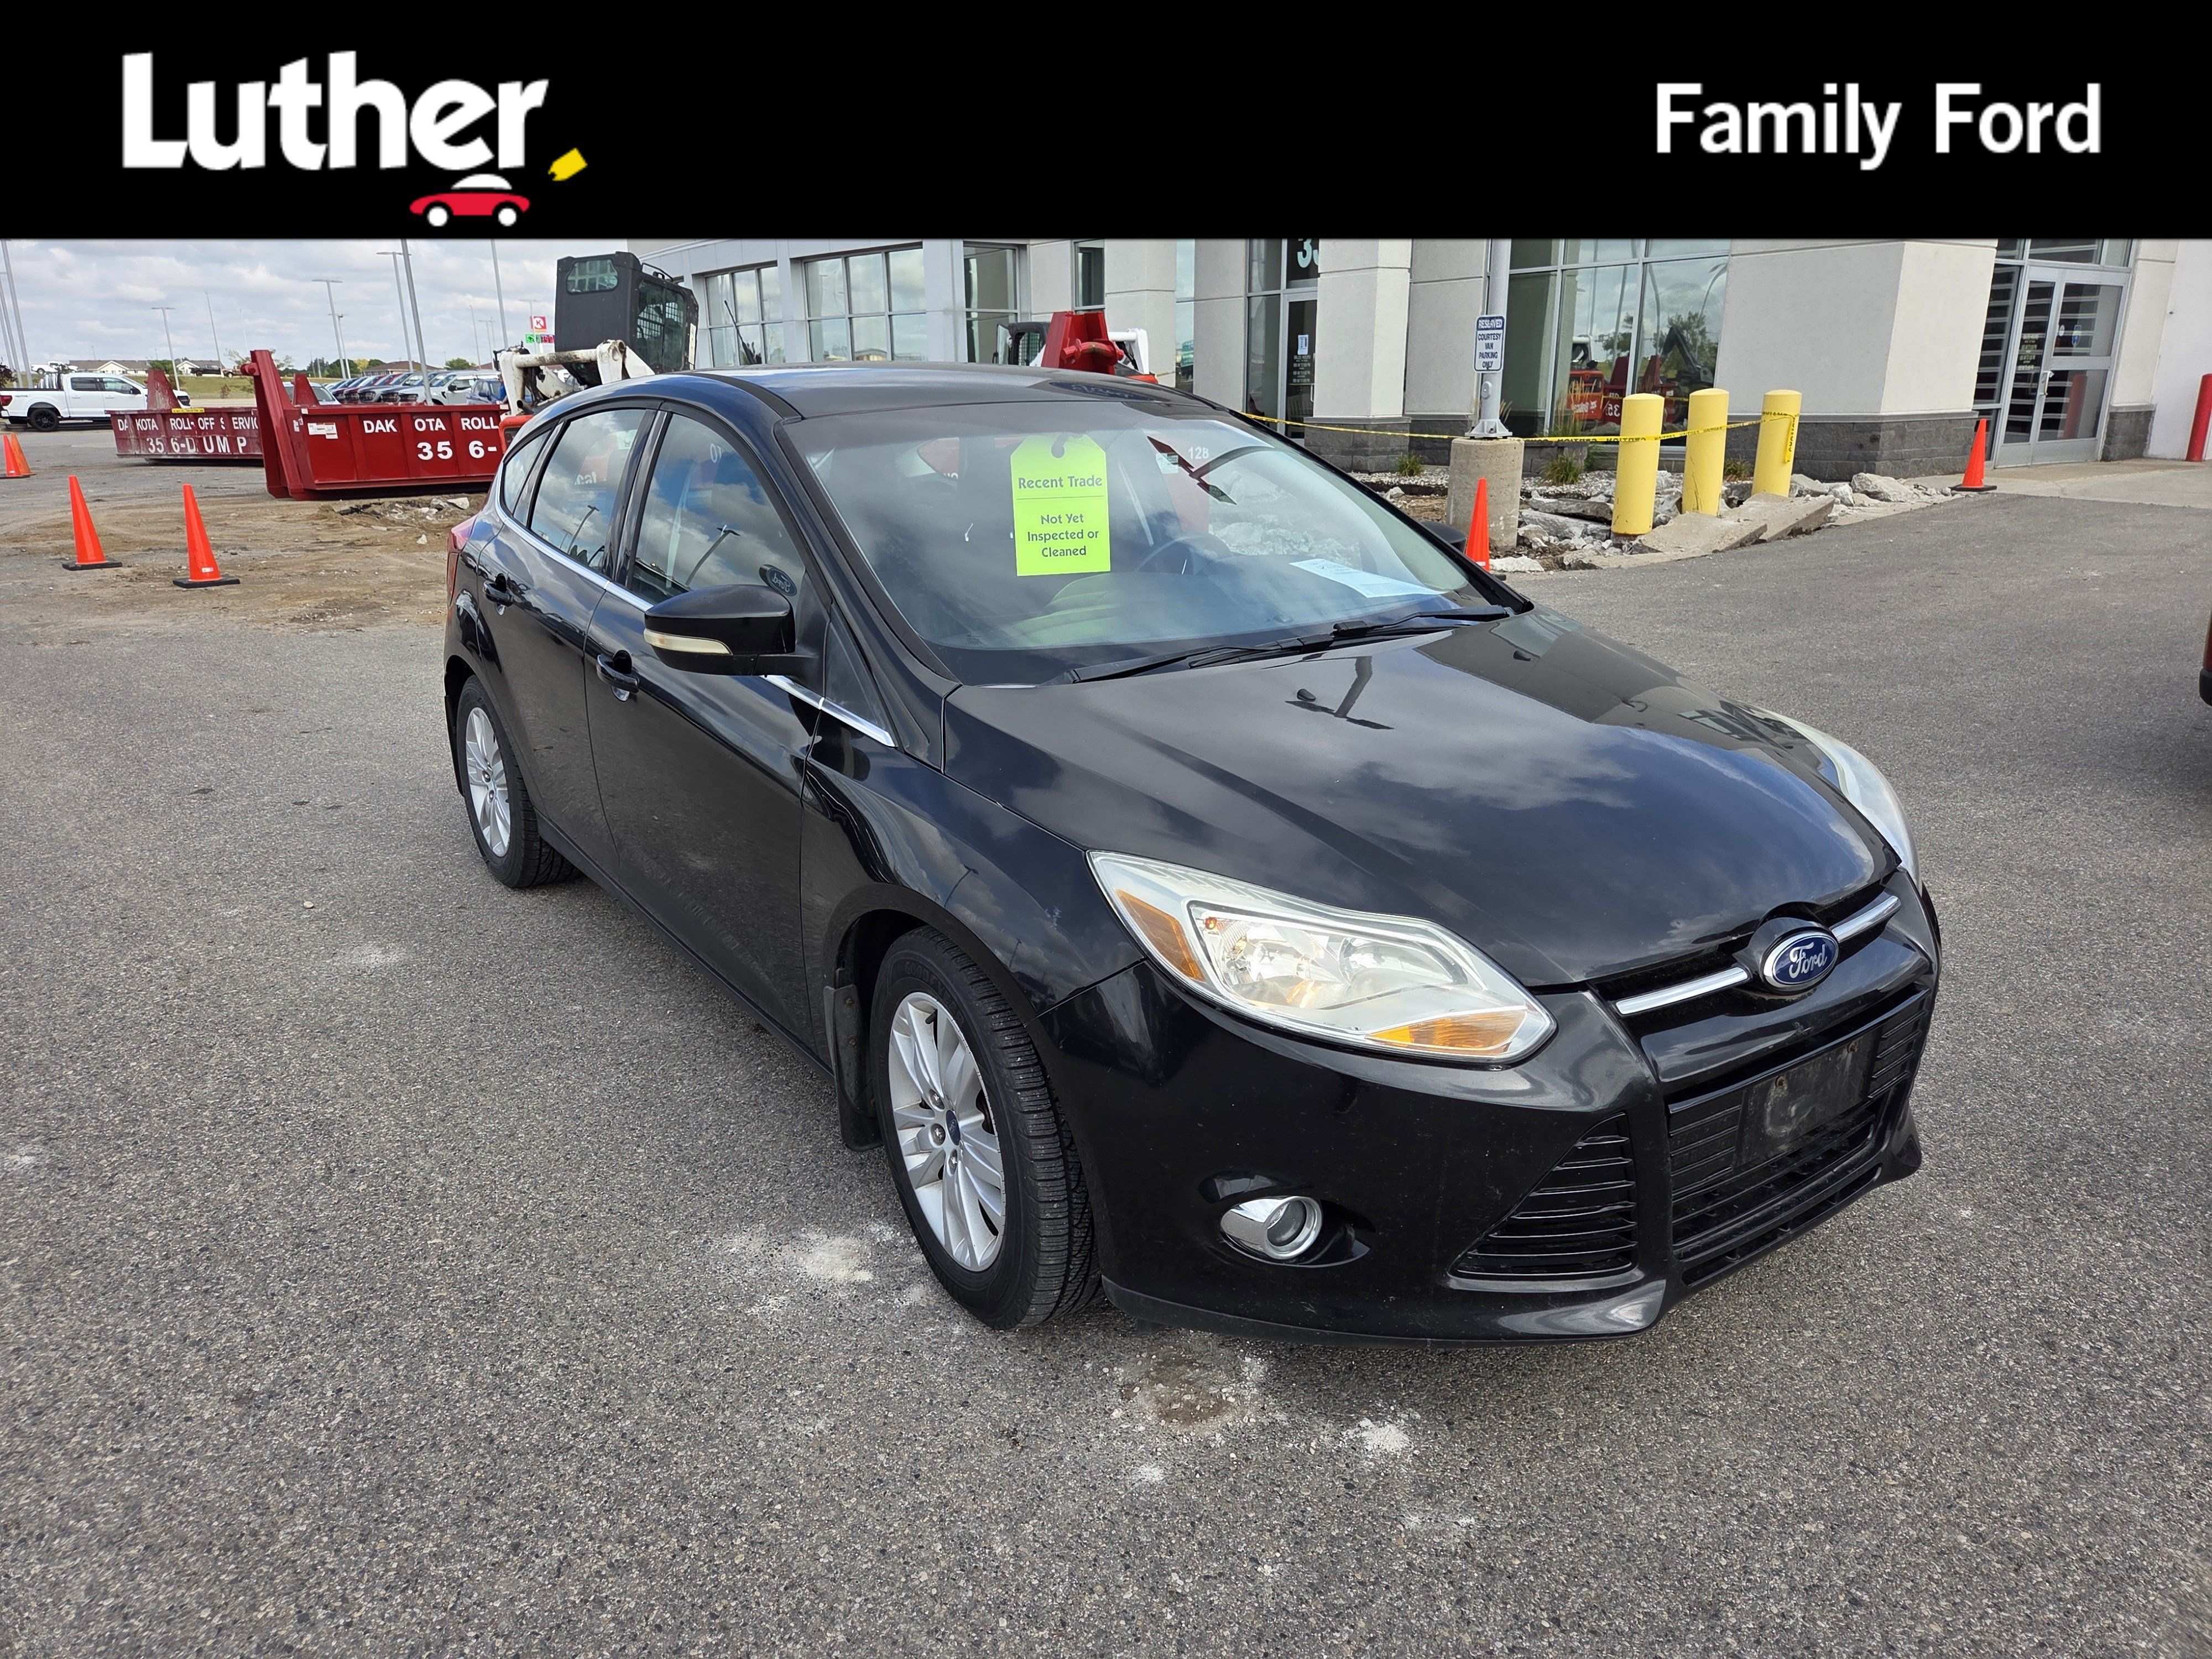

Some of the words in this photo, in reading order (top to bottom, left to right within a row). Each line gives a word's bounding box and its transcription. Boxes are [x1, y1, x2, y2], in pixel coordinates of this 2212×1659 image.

[1478, 320, 1503, 329] RESERVED
[1478, 333, 1501, 341] COURTESY
[1018, 476, 1064, 489] Recent
[1067, 475, 1103, 488] Trade
[1041, 514, 1063, 525] Not
[1066, 513, 1084, 524] Yet
[1027, 529, 1084, 543] Inspected
[1087, 530, 1099, 539] or
[1041, 545, 1087, 557] Cleaned
[1788, 941, 1828, 979] Ford
